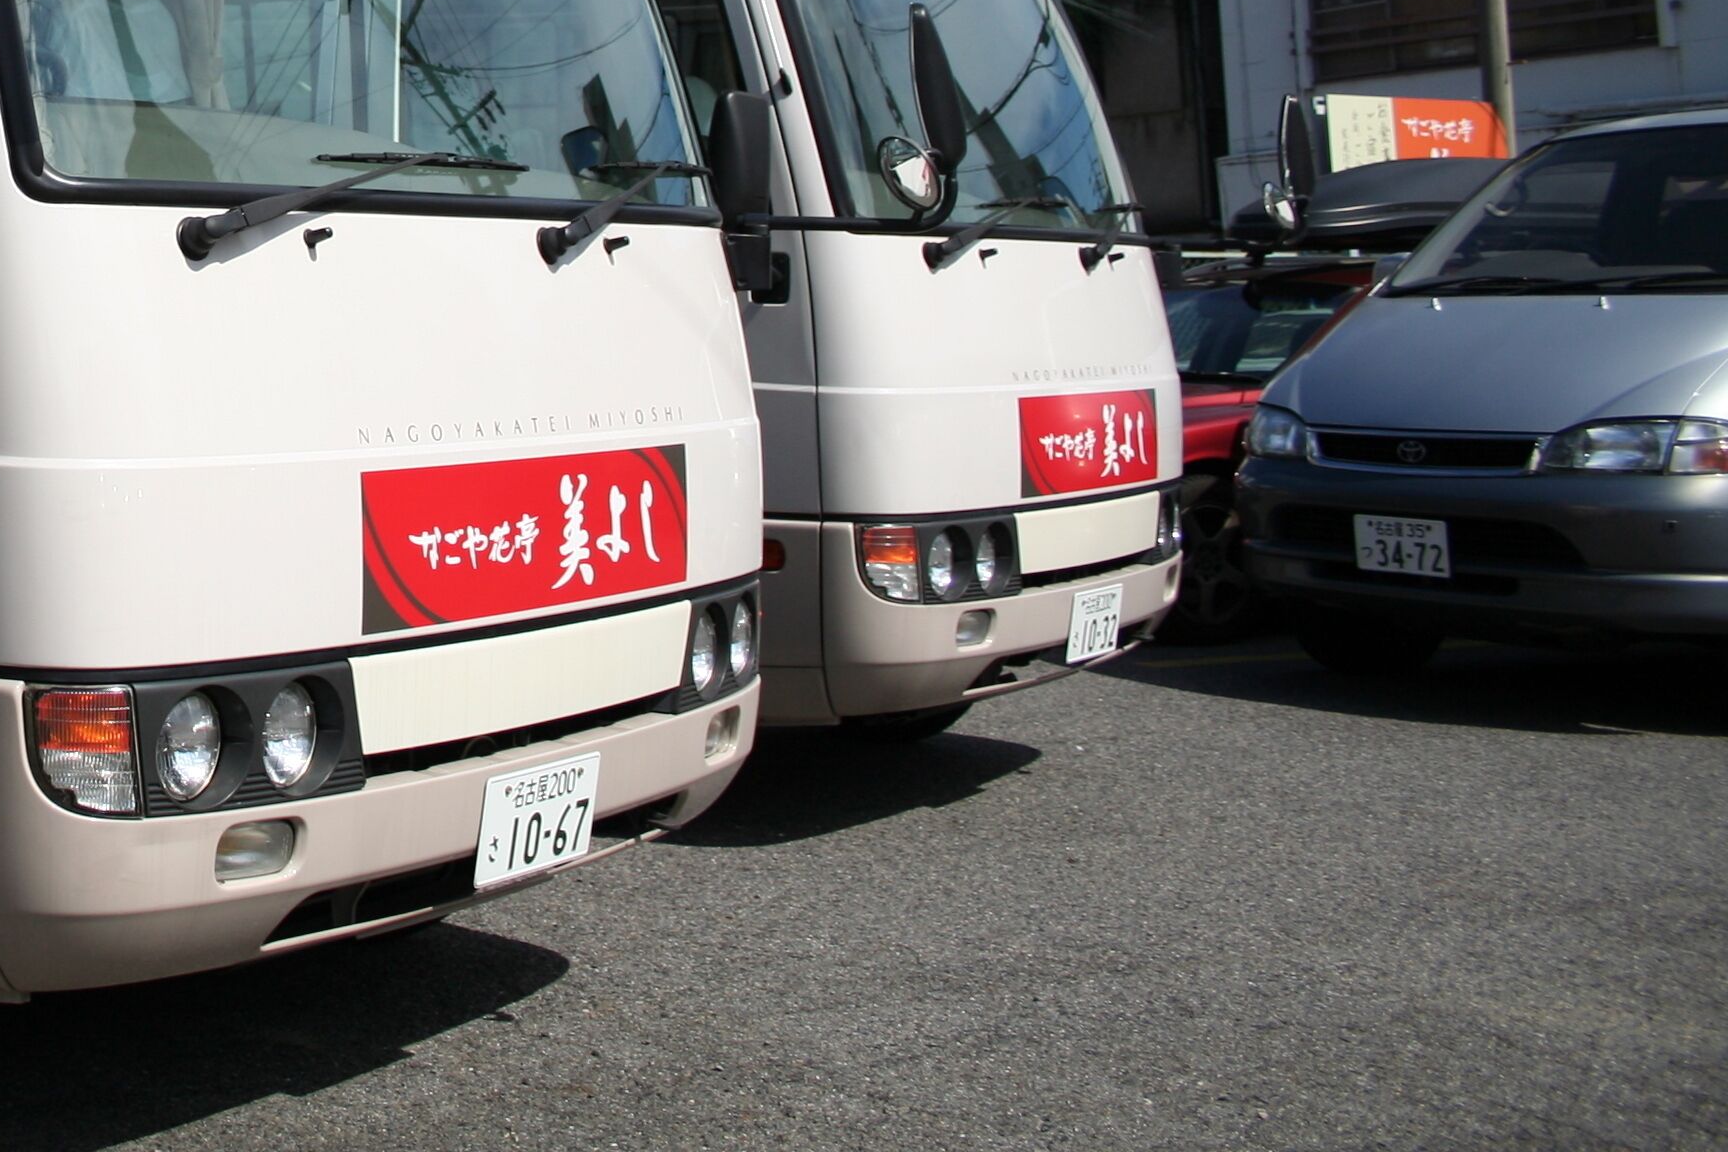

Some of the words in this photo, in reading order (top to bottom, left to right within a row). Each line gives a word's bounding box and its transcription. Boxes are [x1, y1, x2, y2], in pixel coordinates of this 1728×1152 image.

[358, 415, 571, 445] NAGOYAKATEI
[589, 406, 684, 429] MIYOSHI
[551, 473, 660, 590] 美よし
[1375, 539, 1445, 573] 34-72
[513, 767, 576, 808] 名古屋200
[508, 797, 589, 870] 10-67
